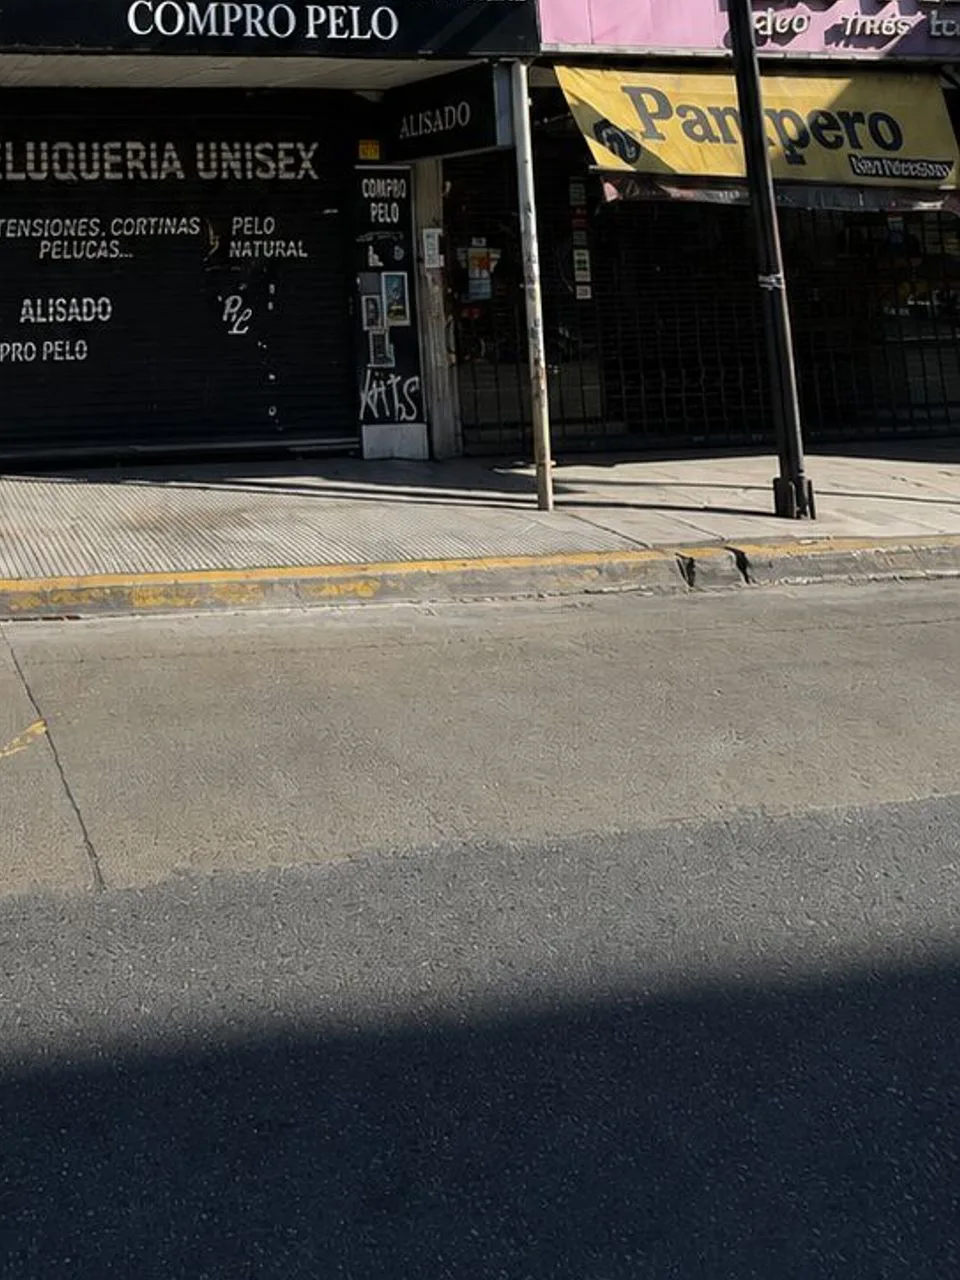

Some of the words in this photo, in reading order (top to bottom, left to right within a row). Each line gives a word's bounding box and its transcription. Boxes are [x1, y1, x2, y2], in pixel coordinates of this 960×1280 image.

[128, 0, 296, 39] COMPRO
[305, 4, 399, 41] PELO
[399, 101, 471, 139] ALISADO
[195, 141, 320, 180] UNISEX
[370, 201, 400, 224] PELO
[111, 216, 201, 236] CORTINAS
[231, 216, 276, 236] PELO
[228, 240, 309, 258] NATURAL
[19, 296, 113, 324] ALISADO
[42, 339, 88, 361] PELO
